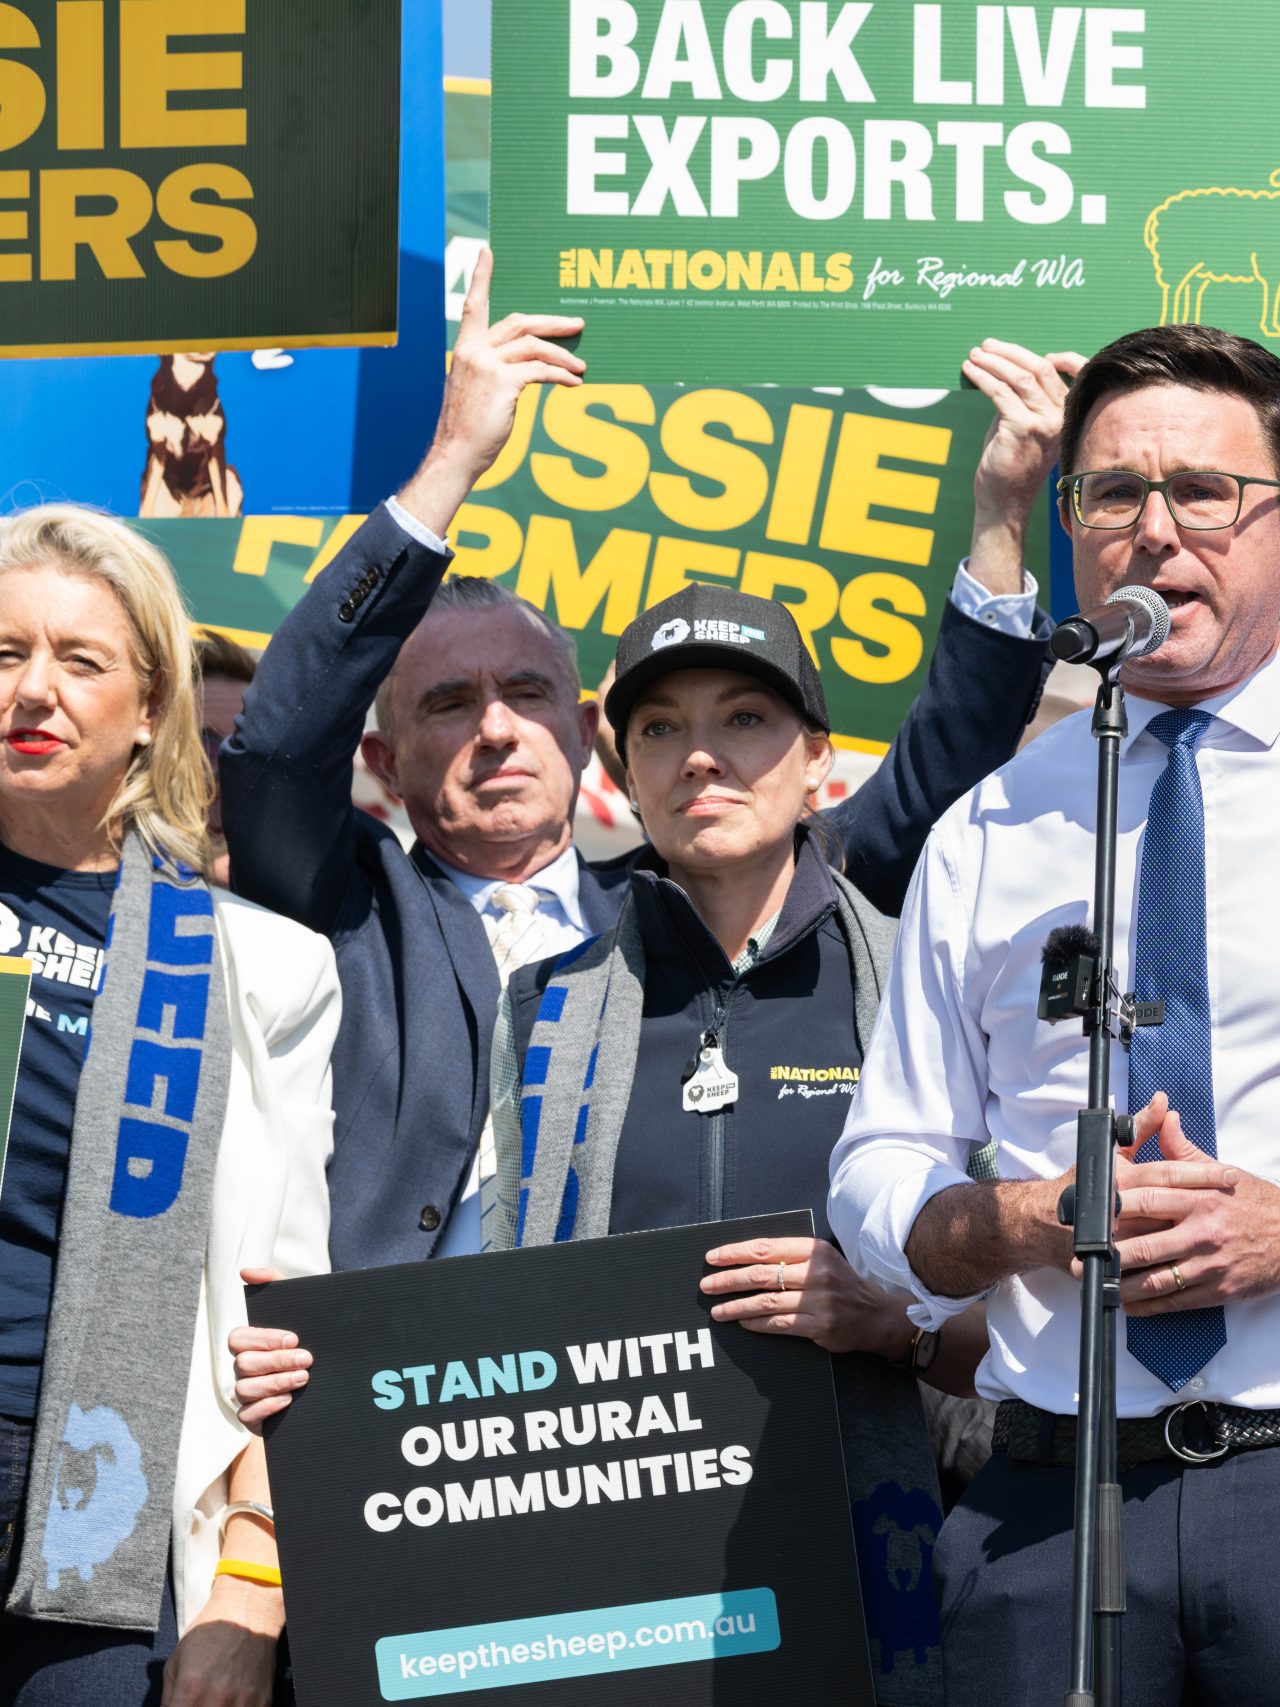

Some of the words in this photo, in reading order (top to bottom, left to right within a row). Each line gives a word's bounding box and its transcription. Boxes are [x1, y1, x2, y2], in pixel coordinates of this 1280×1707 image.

[568, 0, 876, 102] BACK
[913, 3, 1146, 108] LIVE
[567, 114, 1106, 224] EXPORTS.
[560, 249, 576, 289] THE
[577, 248, 853, 292] NATIONALS
[863, 257, 904, 299] for
[916, 257, 1024, 296] Regional
[1031, 254, 1085, 289] WA
[468, 384, 953, 567] USSIE
[693, 619, 740, 633] KEEP
[694, 630, 751, 644] SHEEP
[23, 951, 101, 991] SHE
[27, 926, 104, 968] KEE
[777, 1066, 862, 1082] NATIONAL
[371, 1350, 558, 1410] STAND
[565, 1328, 715, 1385] WITH
[401, 1417, 518, 1468] OUR
[525, 1391, 703, 1453] RURAL
[363, 1445, 754, 1534] COMMUNITIES
[400, 1608, 757, 1681] keepthesheep.com.au
